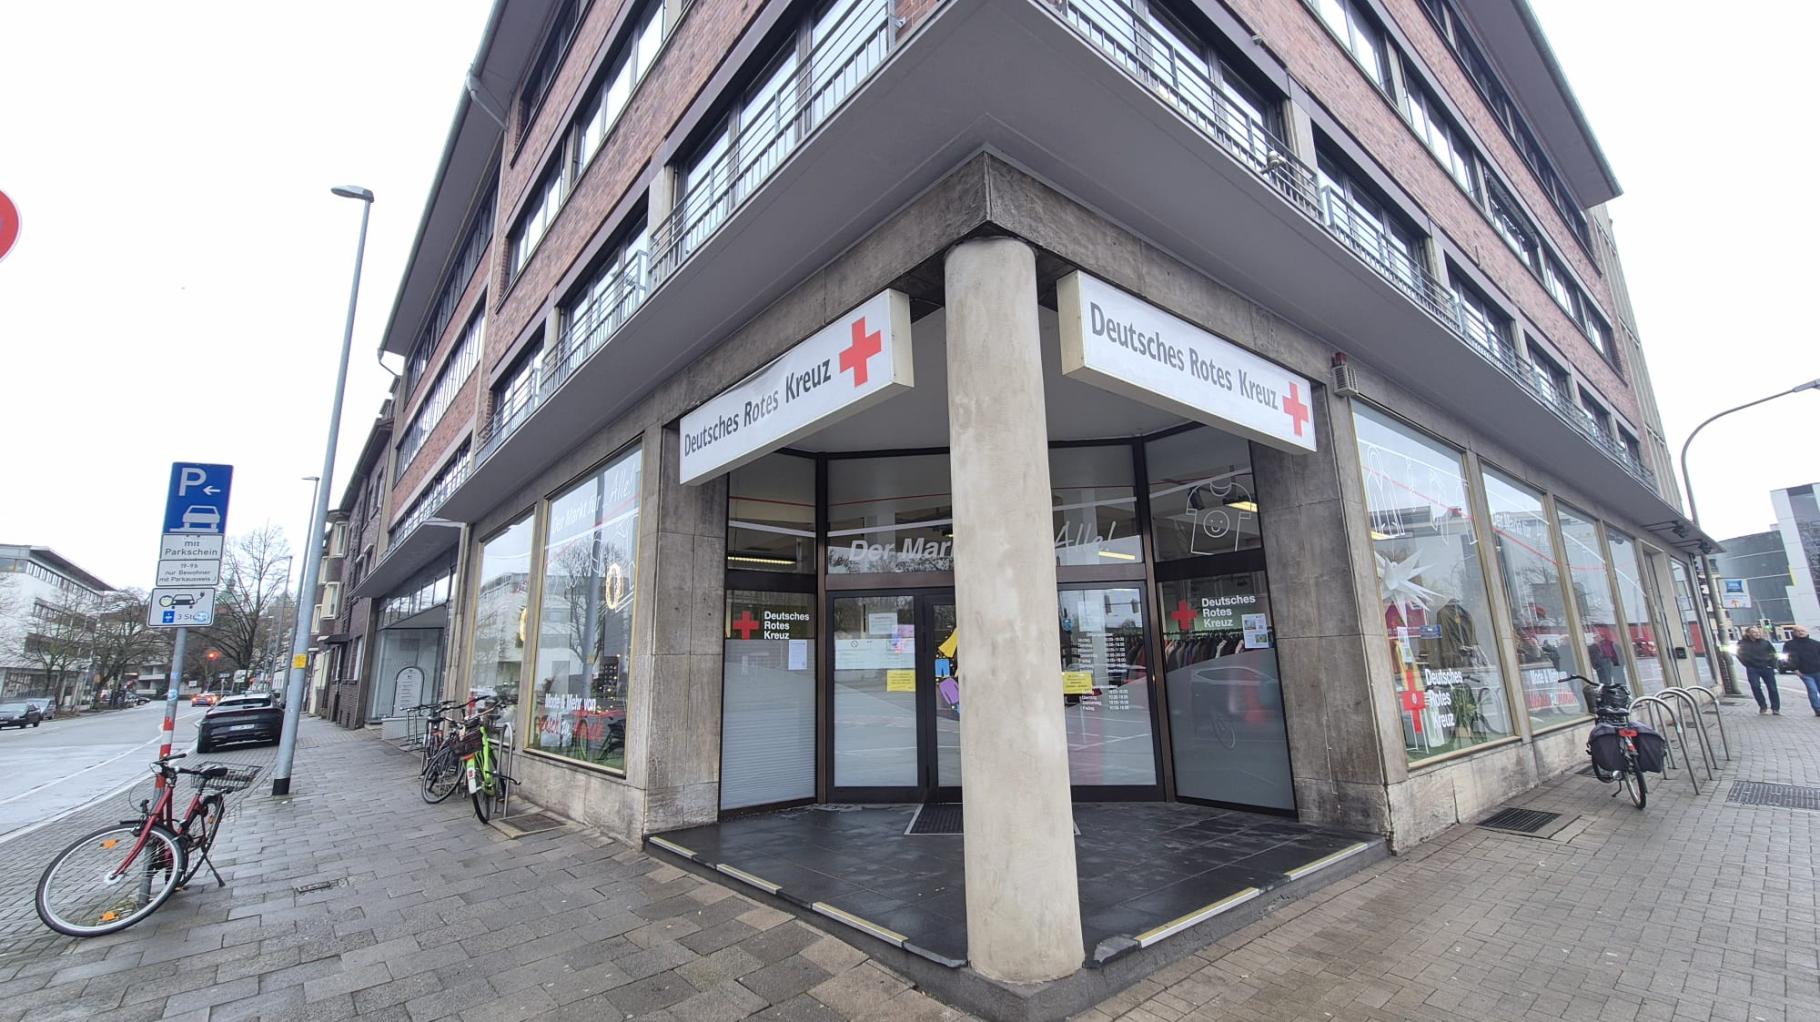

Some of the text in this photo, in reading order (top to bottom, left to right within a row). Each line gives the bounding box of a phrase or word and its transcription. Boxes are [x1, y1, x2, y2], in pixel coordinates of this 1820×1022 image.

[1090, 302, 1279, 410] Deutsches Rotes Kreuz
[684, 358, 832, 457] Deutsches Rotes Kreuz
[178, 467, 207, 496] P
[165, 548, 218, 556] Parkschein
[849, 537, 953, 561] Der Mar
[1202, 595, 1256, 607] Deutsches
[764, 611, 810, 621] Deutsches
[1203, 608, 1232, 617] Rotes
[764, 621, 790, 630] Rotes
[1204, 619, 1233, 628] Kreuz
[764, 631, 790, 640] Kreuz
[1425, 668, 1463, 685] Deutsches
[567, 693, 582, 710] Mehr
[1428, 690, 1452, 706] Rotes
[1433, 713, 1456, 728] Kreuz
